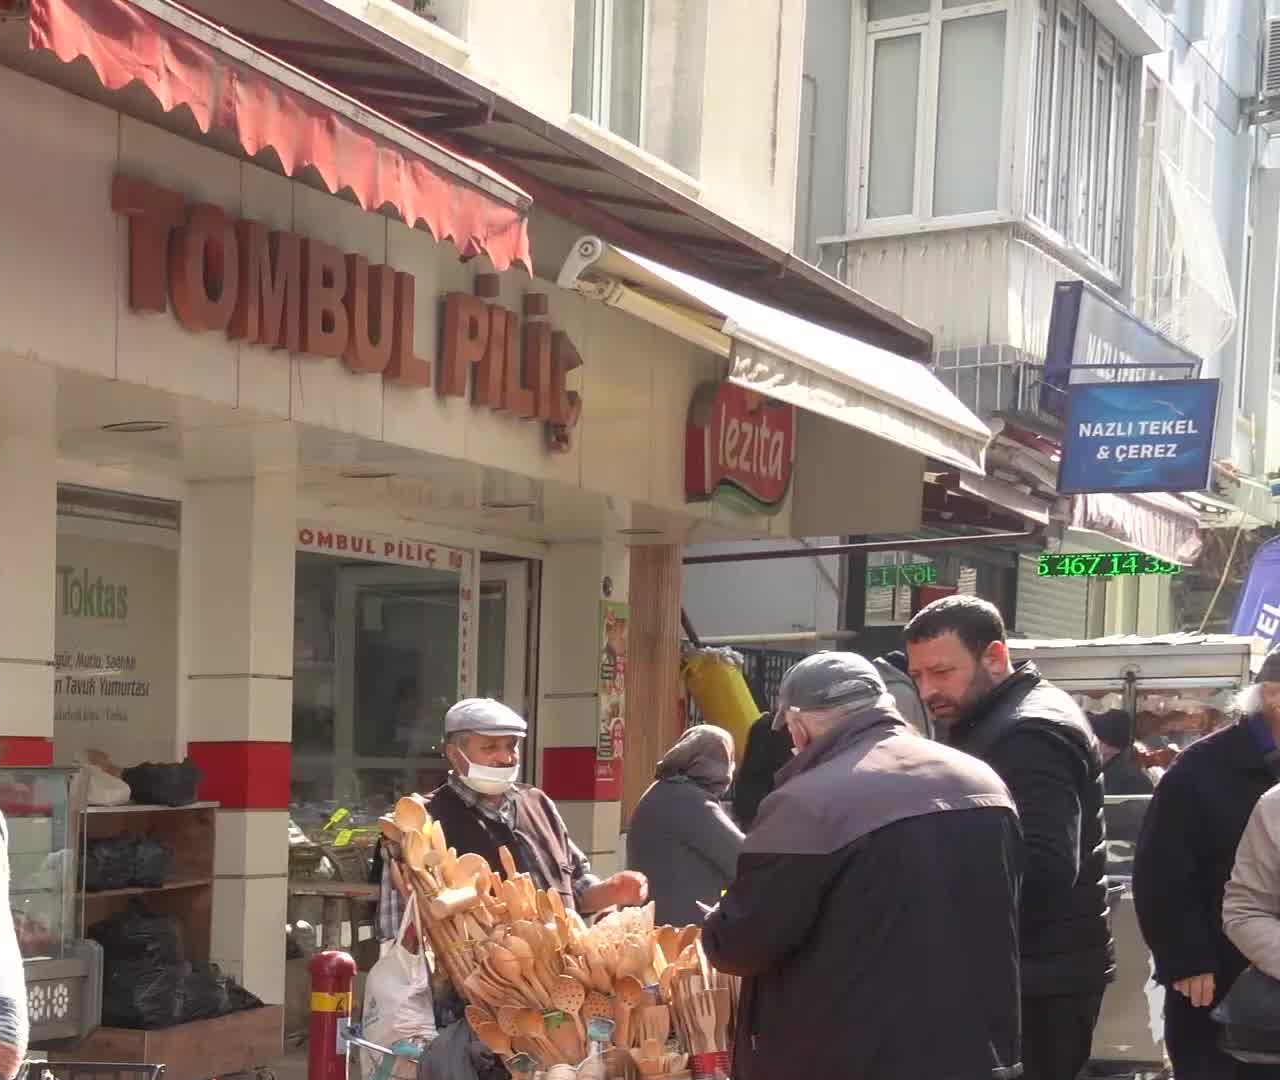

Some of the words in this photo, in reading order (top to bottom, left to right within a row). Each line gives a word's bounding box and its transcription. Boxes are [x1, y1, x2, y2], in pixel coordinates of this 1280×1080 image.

[111, 172, 431, 388] TOMBUL
[437, 272, 584, 453] PİLİÇ
[1078, 422, 1134, 438] NAZLI
[1138, 419, 1199, 436] TEKEL
[1096, 446, 1111, 460] &
[1114, 443, 1178, 463] ÇEREZ
[298, 528, 377, 554] OMBUL
[1056, 556, 1101, 575] 467
[1110, 556, 1138, 575] 14
[65, 676, 95, 696] Tavuk
